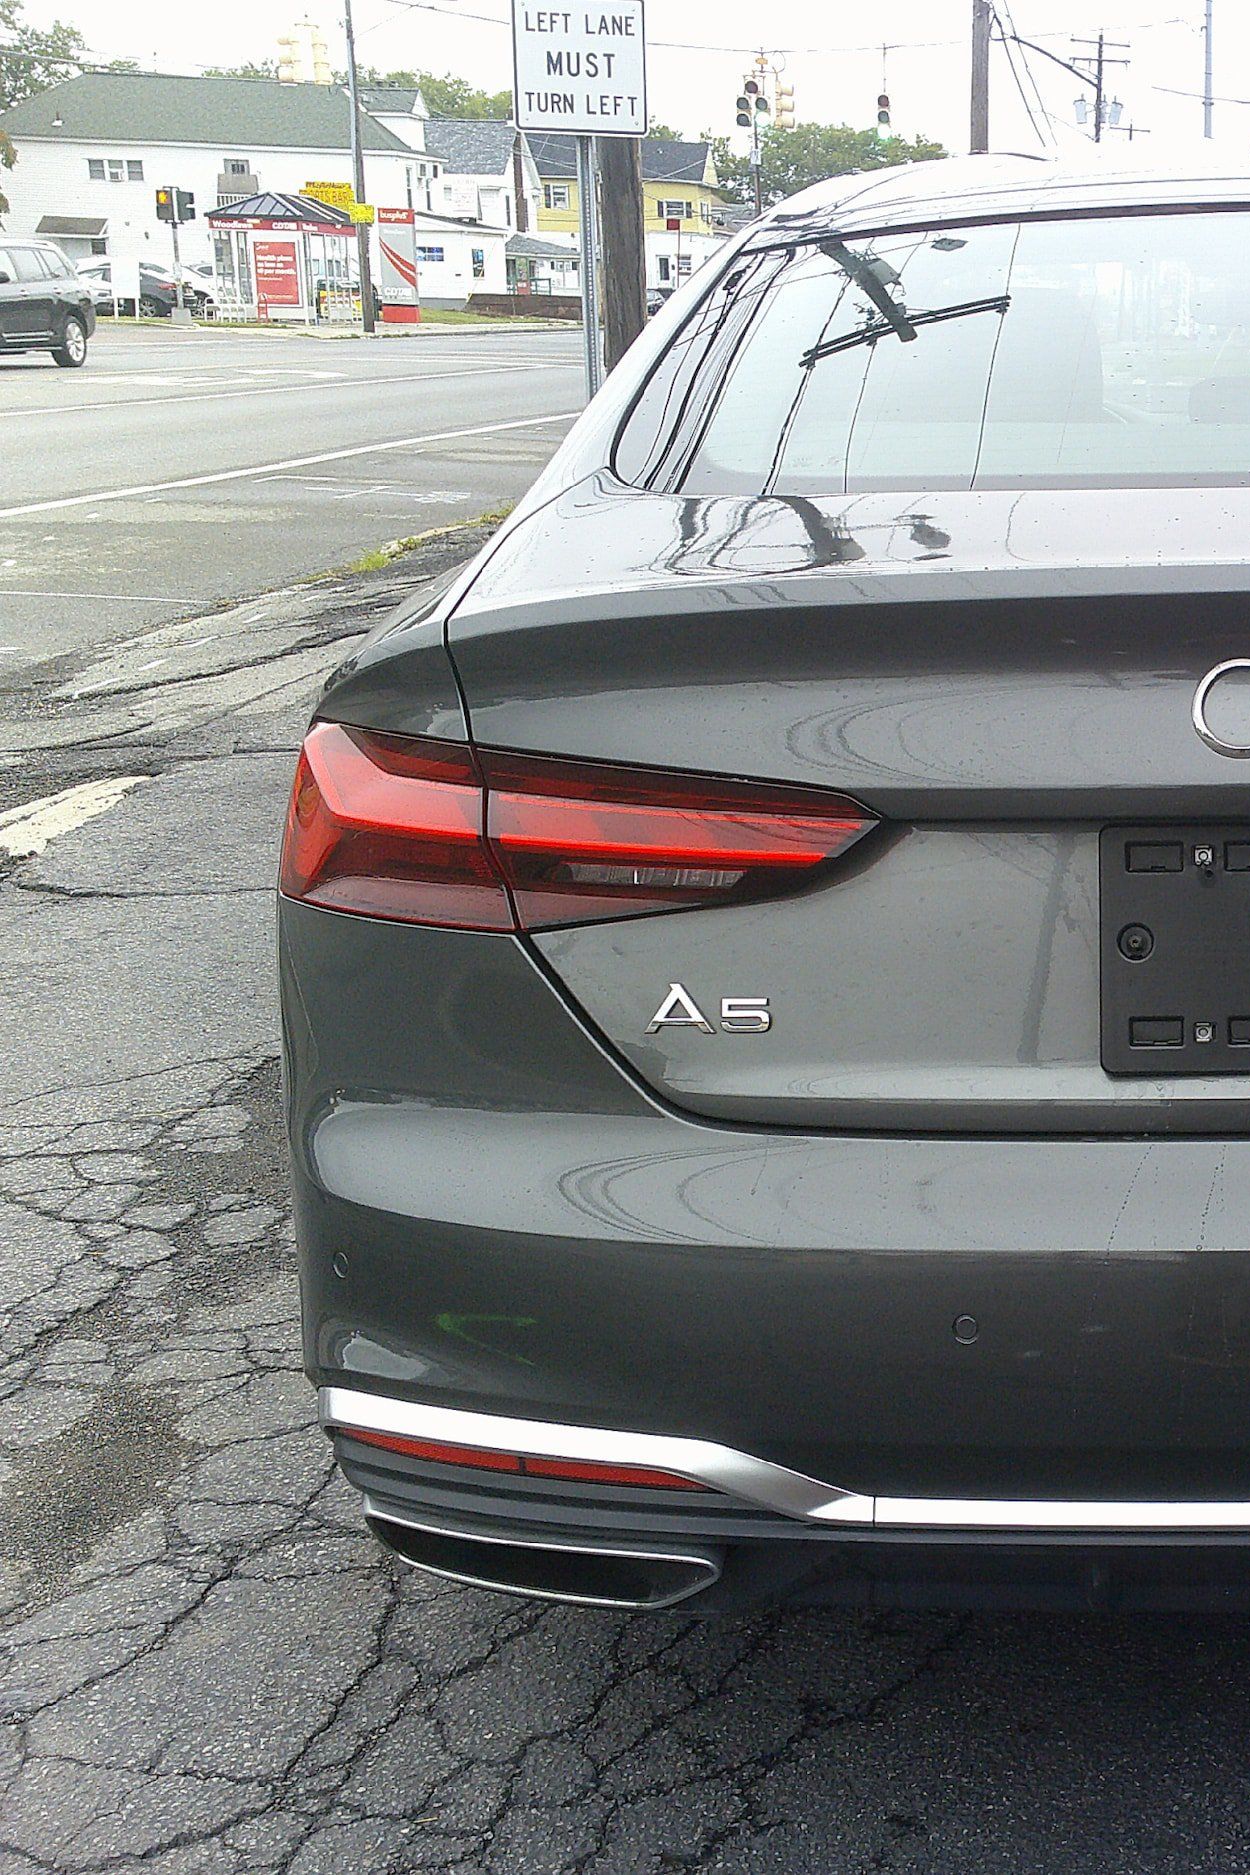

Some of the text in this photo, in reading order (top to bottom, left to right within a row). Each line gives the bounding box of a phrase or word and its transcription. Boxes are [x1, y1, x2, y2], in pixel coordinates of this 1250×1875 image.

[525, 11, 635, 36] LEFT LANE
[546, 51, 615, 78] MUST
[525, 92, 638, 117] TURN LEFT
[644, 981, 771, 1034] A5
